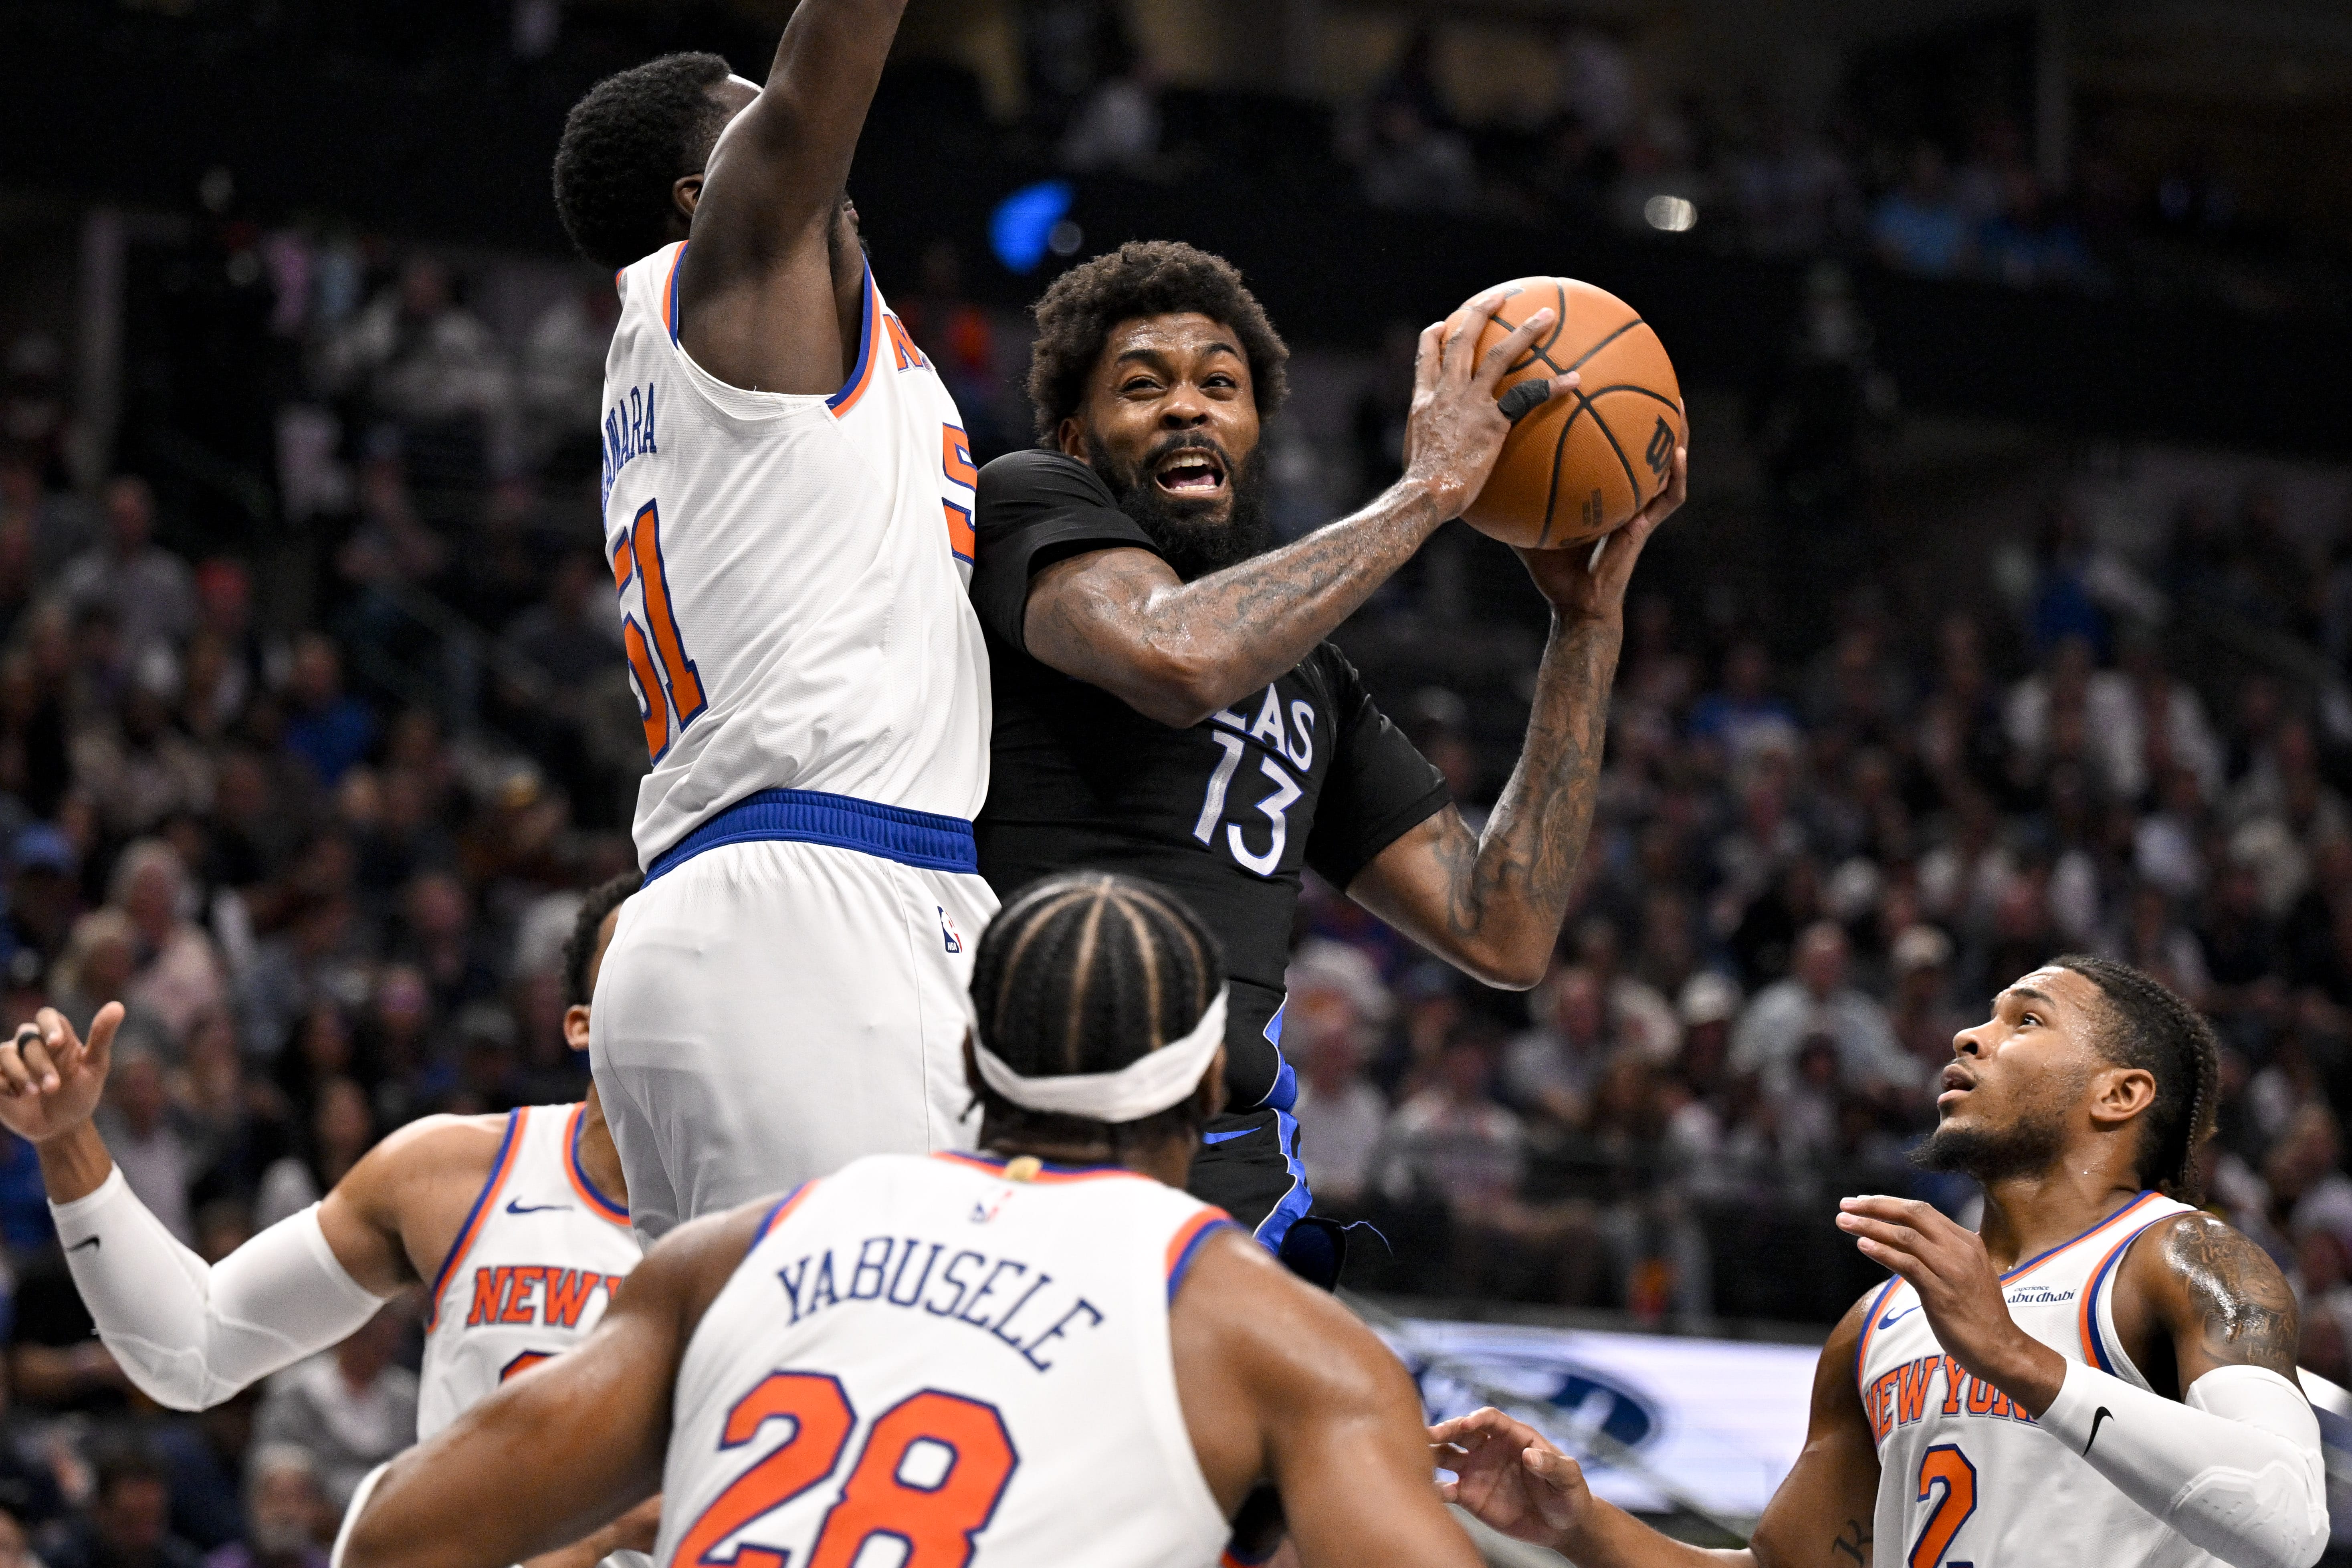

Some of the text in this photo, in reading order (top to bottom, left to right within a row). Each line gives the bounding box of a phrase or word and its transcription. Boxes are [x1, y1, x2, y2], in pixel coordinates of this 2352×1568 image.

[602, 382, 658, 535] AWARA
[1192, 729, 1304, 877] 13
[947, 942, 958, 951] NBA
[465, 1265, 601, 1329] NEW
[776, 1236, 1105, 1373] YABUSELE
[2008, 1289, 2077, 1303] abu dhabi
[1865, 1354, 2039, 1447] NEW YO
[670, 1370, 1021, 1568] 28
[1908, 1443, 1977, 1568] 2
